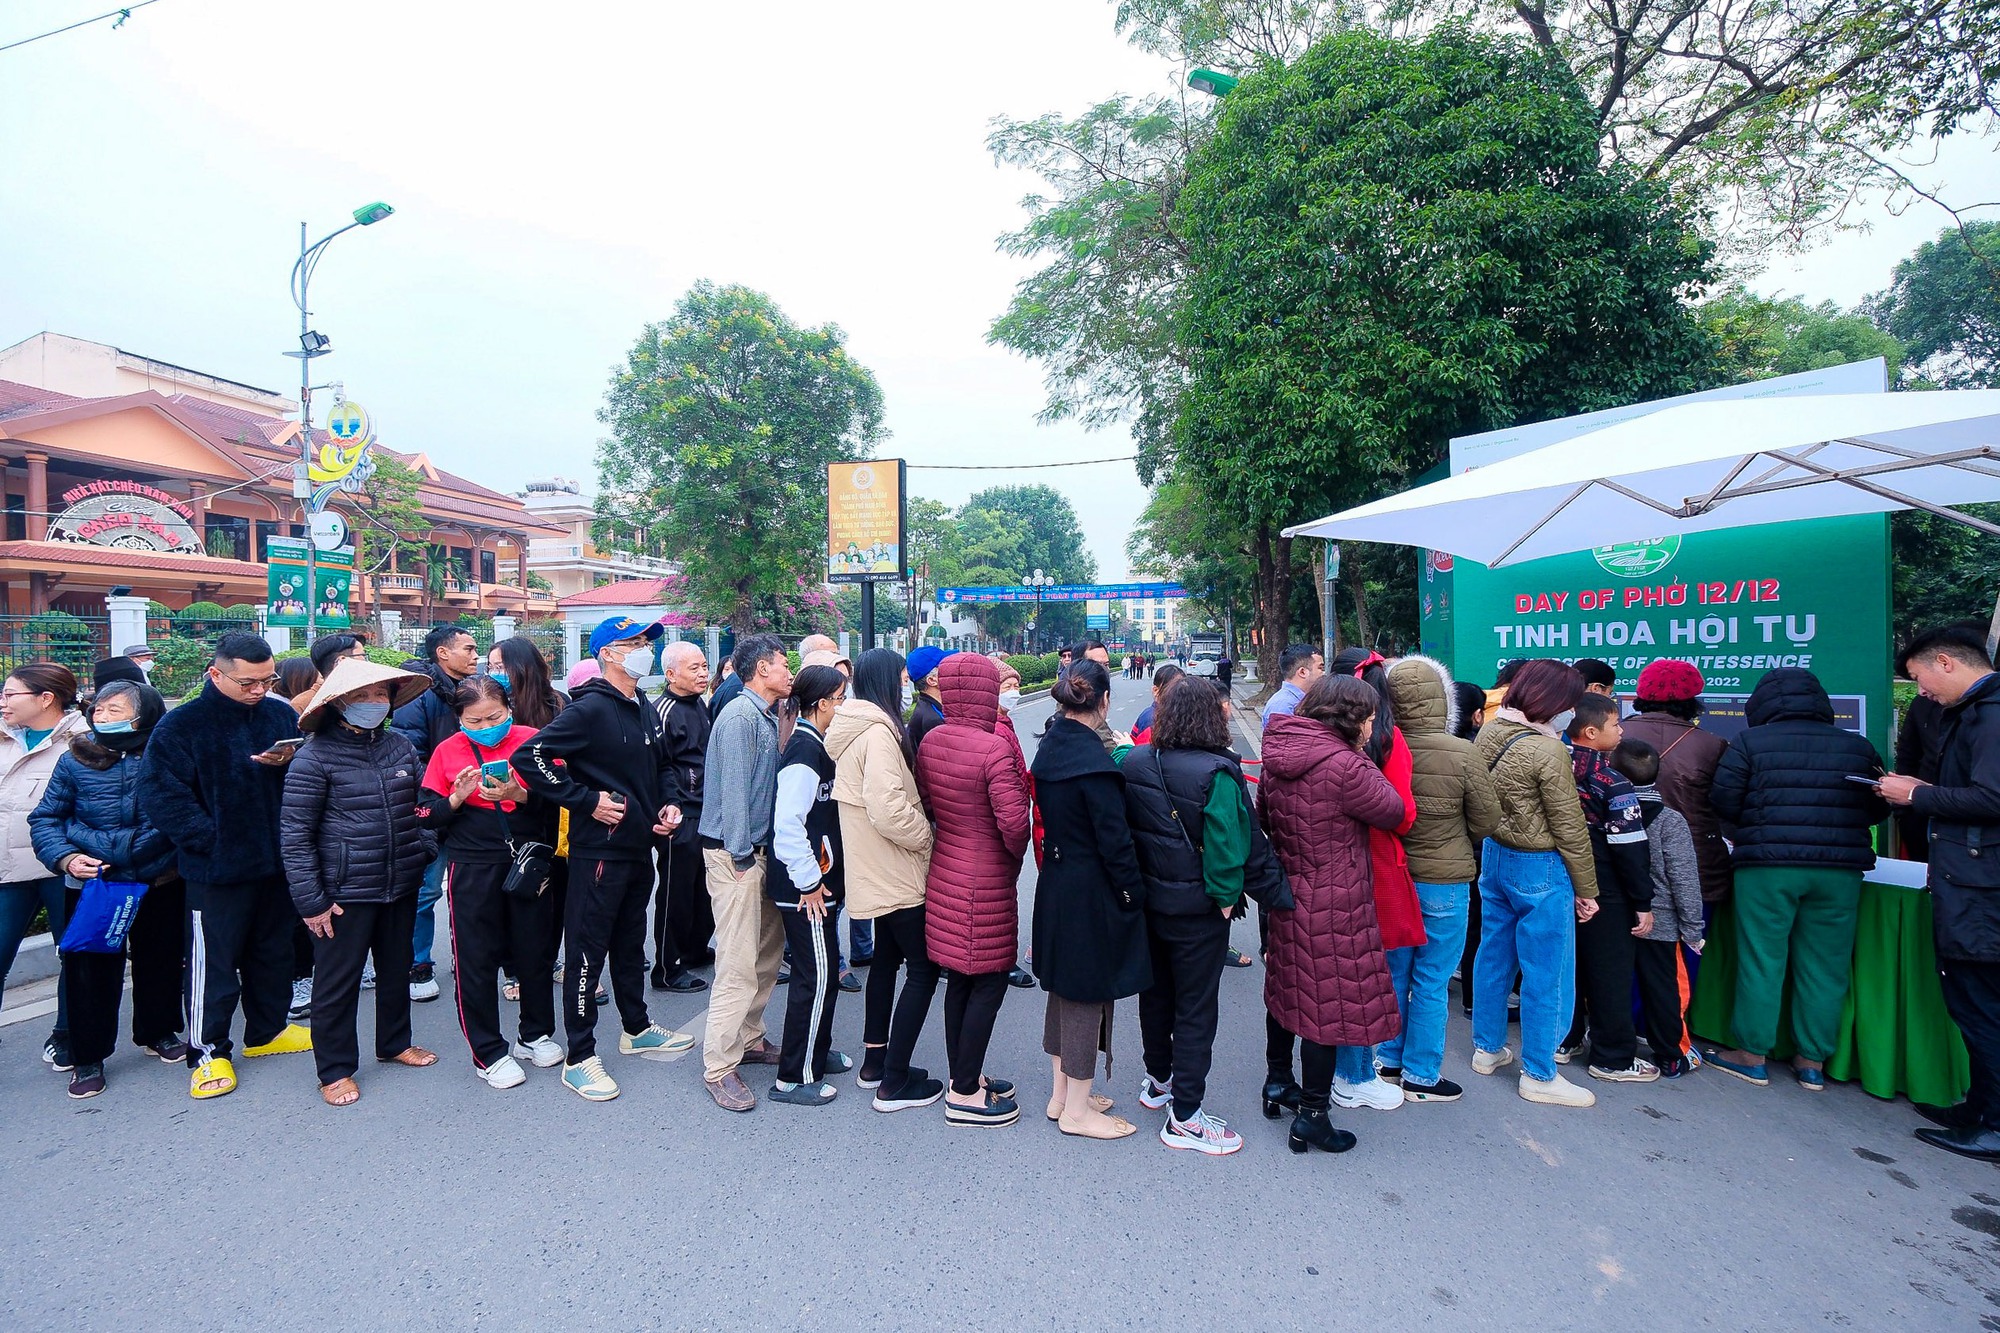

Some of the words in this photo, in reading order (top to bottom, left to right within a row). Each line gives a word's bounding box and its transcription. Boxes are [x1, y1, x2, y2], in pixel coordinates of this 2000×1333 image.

[63, 484, 91, 504] NHÀ
[88, 480, 110, 496] HÁT
[112, 480, 140, 494] CHÈO
[142, 485, 169, 503] NAM
[1515, 592, 1570, 614] DAY
[1578, 588, 1614, 610] OF
[1624, 576, 1688, 608] PHỞ
[1697, 578, 1780, 604] 12/12
[1494, 623, 1569, 648] TINH
[1580, 620, 1655, 646] HOA
[1670, 612, 1738, 648] HỘI
[1754, 614, 1816, 647] TỤ
[1623, 656, 1648, 669] OF
[1706, 677, 1740, 687] 2022
[534, 756, 546, 770] DO
[540, 769, 562, 784] JUST
[579, 977, 587, 992] DO
